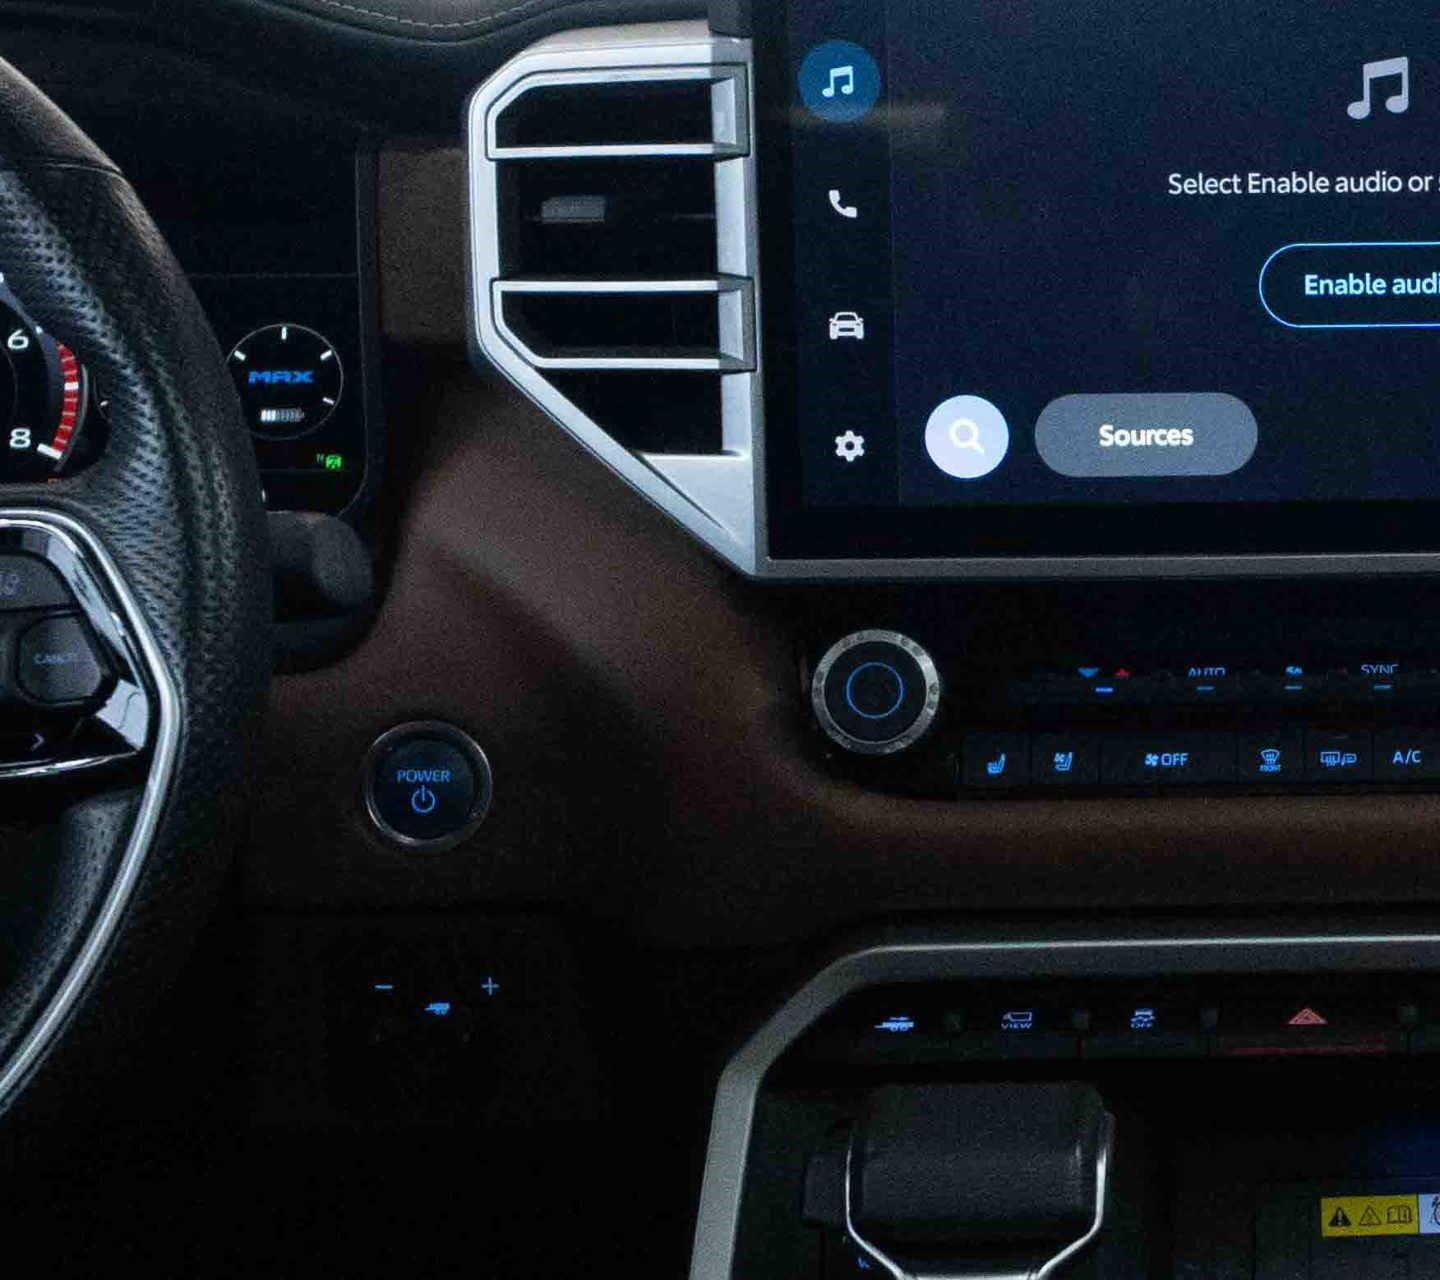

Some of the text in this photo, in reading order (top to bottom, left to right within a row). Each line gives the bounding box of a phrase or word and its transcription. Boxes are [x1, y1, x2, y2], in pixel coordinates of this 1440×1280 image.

[1168, 172, 1242, 195] Select
[1247, 172, 1330, 194] Enable
[1334, 171, 1402, 193] audio
[1407, 175, 1435, 192] or
[1303, 273, 1386, 296] Enable
[7, 329, 29, 350] 6
[247, 370, 315, 384] MAX
[9, 427, 32, 449] 8
[1098, 423, 1195, 447] Sources
[1161, 752, 1190, 767] OFF
[1392, 750, 1422, 765] A/C
[396, 768, 452, 783] POWER
[1001, 1022, 1033, 1030] VIEW
